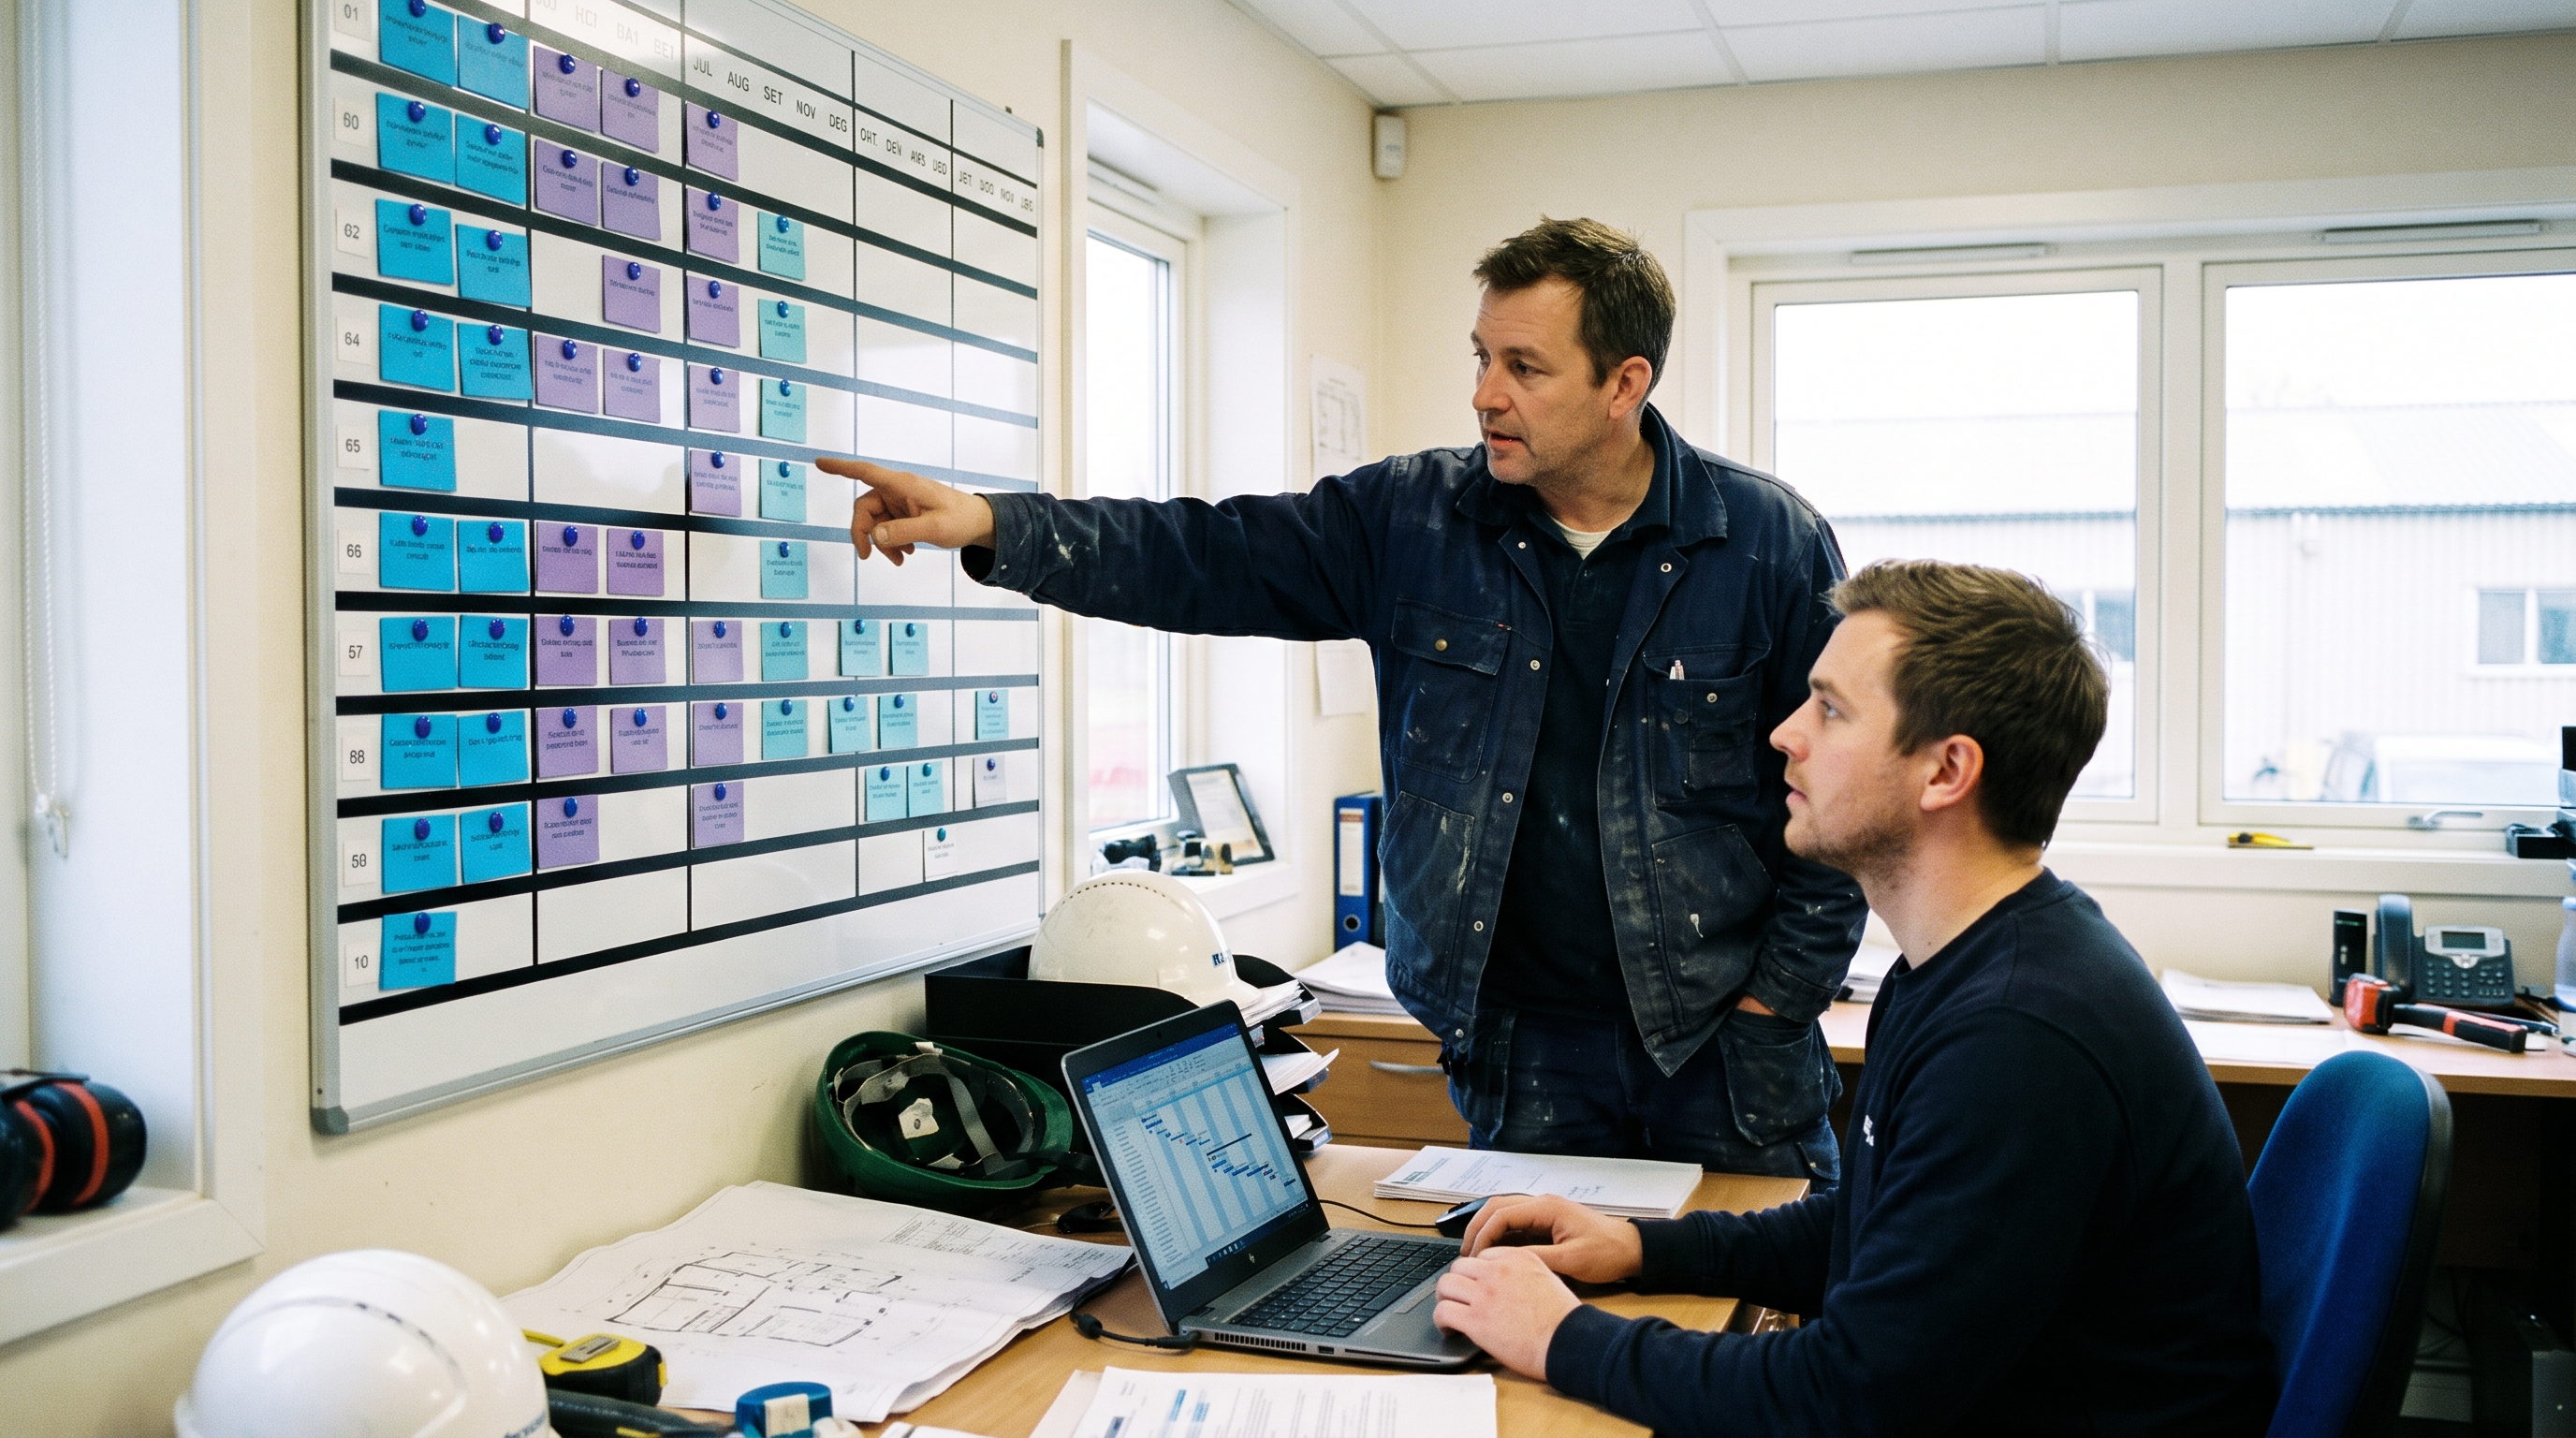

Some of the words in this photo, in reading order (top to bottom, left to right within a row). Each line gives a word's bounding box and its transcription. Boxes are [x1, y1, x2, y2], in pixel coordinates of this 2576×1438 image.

[344, 4, 358, 21] 01
[694, 59, 712, 77] JUL
[727, 72, 749, 92] AUG
[764, 86, 783, 105] SET
[797, 100, 815, 119] NOV
[829, 114, 847, 132] DEG
[344, 111, 359, 130] 60
[344, 224, 359, 240] 62
[344, 332, 359, 346] 64
[345, 438, 360, 453] 65
[347, 544, 361, 558] 66
[349, 645, 362, 659] 57
[350, 750, 365, 764] 88
[355, 955, 368, 969] 10
